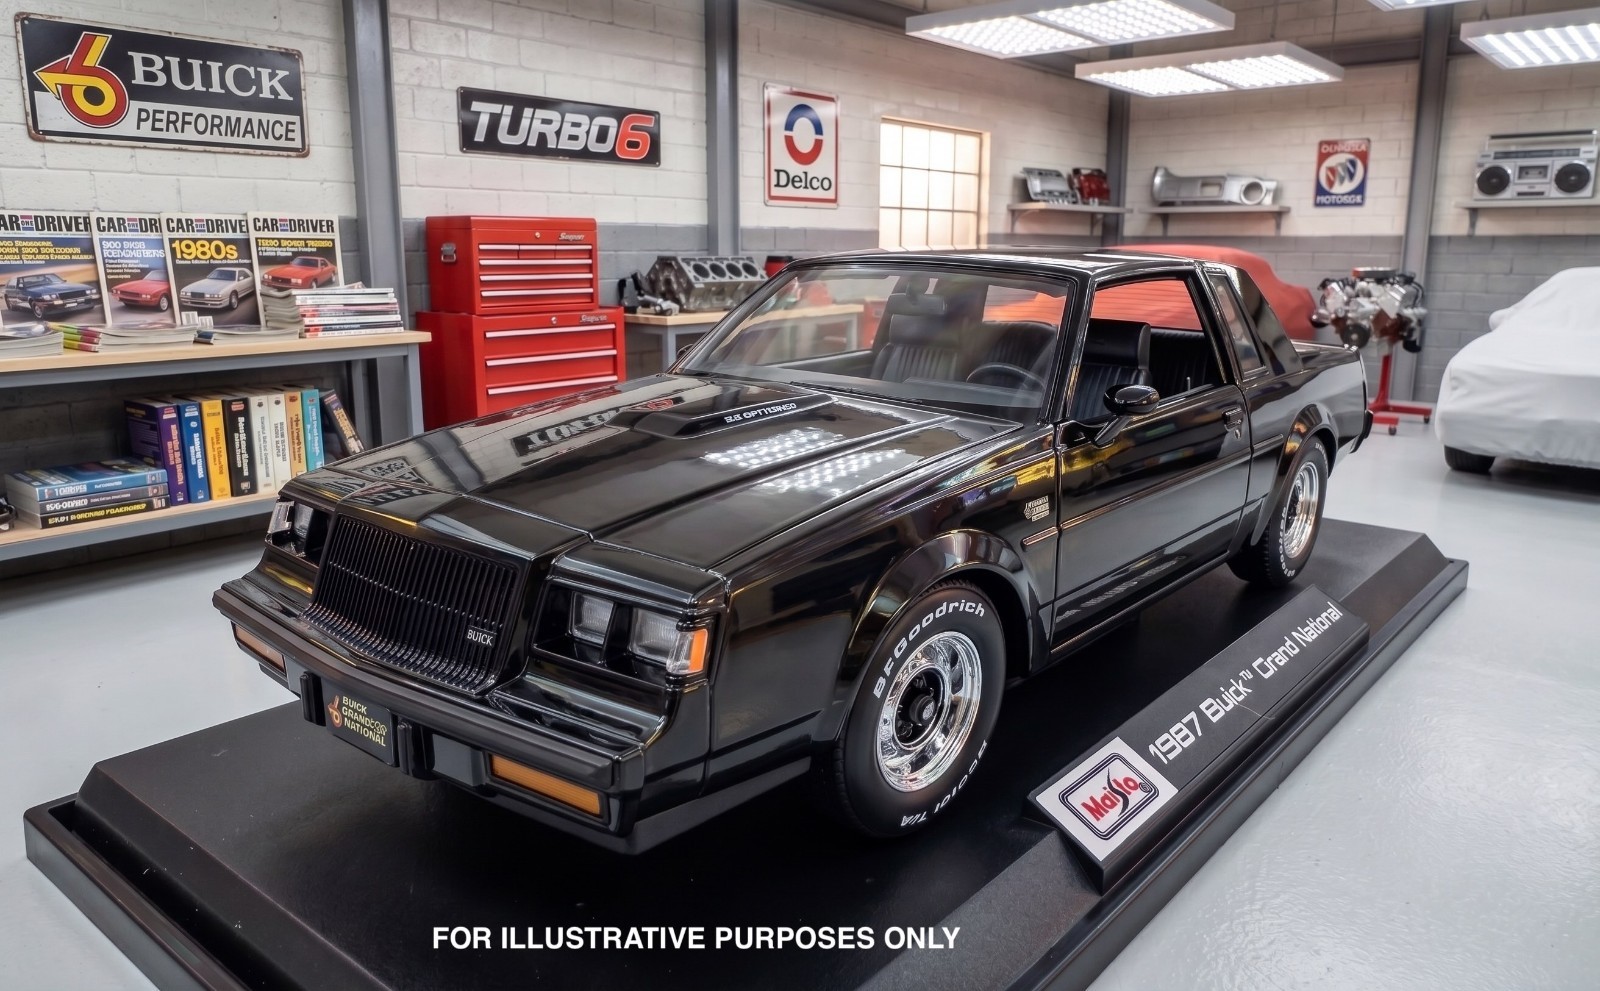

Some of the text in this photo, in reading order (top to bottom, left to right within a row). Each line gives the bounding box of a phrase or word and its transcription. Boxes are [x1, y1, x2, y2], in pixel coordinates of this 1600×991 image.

[127, 51, 294, 101] BUICK
[136, 108, 297, 142] PERFORMANCE
[774, 169, 833, 192] Delco
[96, 216, 127, 233] CAR
[165, 217, 195, 233] CAR
[253, 217, 334, 233] CAR DRIVER
[172, 240, 238, 260] 1980s
[467, 629, 492, 646] BUICK
[873, 600, 985, 699] BFGoodrich
[1148, 711, 1203, 765] 1987
[1199, 678, 1253, 723] Buick
[1252, 636, 1300, 679] Grand
[1294, 602, 1343, 647] National
[342, 695, 367, 715] BUICK
[341, 706, 371, 727] GRAND
[344, 717, 386, 747] NATIONAL
